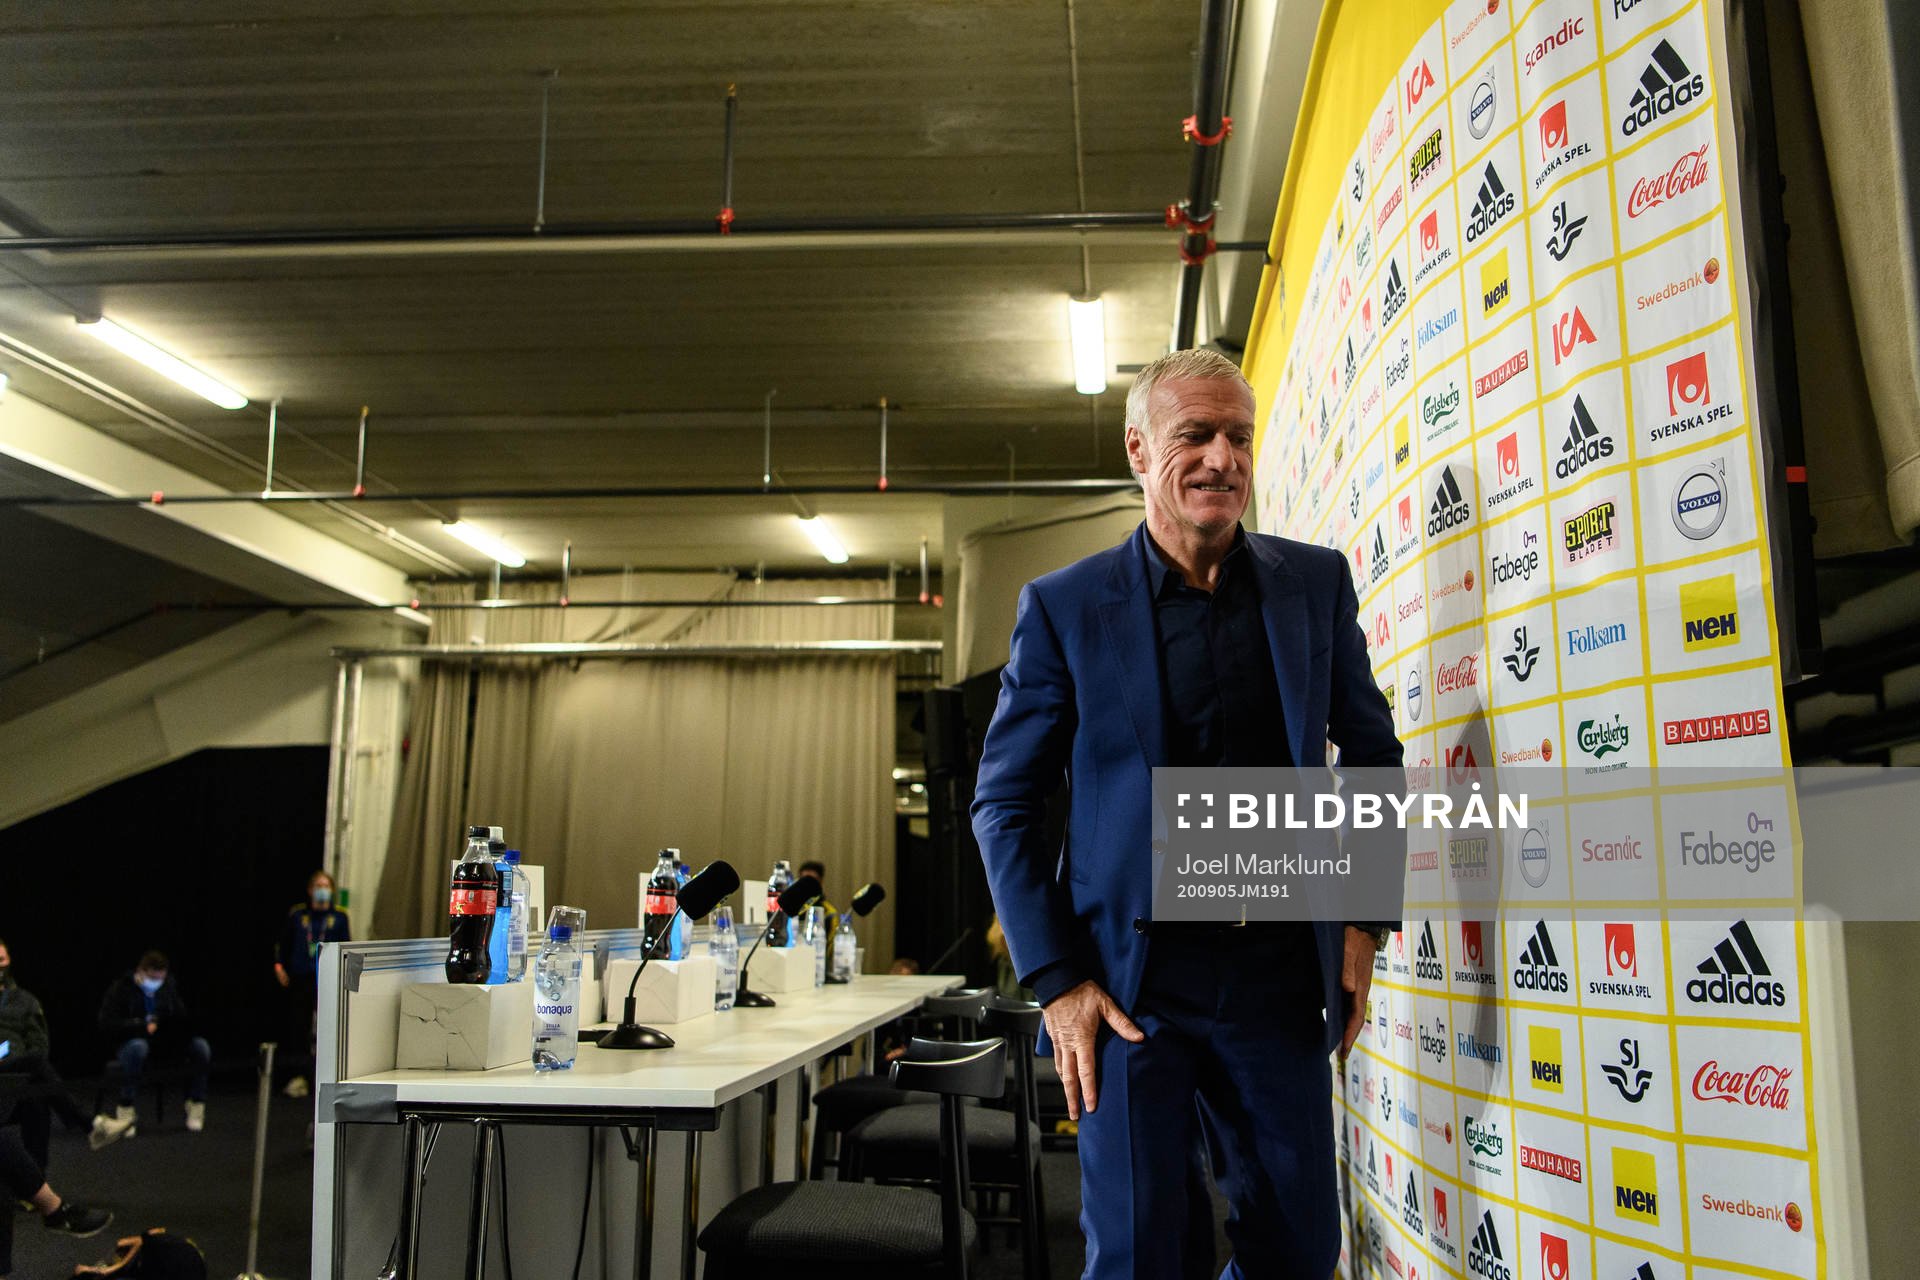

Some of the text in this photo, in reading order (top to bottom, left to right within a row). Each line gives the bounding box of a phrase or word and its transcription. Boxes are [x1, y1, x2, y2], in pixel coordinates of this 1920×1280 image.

[1451, 8, 1488, 49] Swedbank
[1525, 17, 1584, 76] Scandic
[1406, 58, 1435, 115] ICA
[1622, 74, 1704, 136] adidas
[1410, 128, 1442, 184] SPORT
[1535, 143, 1592, 190] SVENSKA SPEL
[1628, 141, 1710, 218] Coca-Cola
[1467, 192, 1515, 243] adidas
[1552, 201, 1567, 233] SJ
[1382, 287, 1407, 327] adidas
[1637, 272, 1703, 311] Swedbank
[1417, 308, 1458, 350] Folksam
[1552, 305, 1598, 366] ICA
[1475, 350, 1528, 398] BAUHAUS
[1423, 390, 1459, 425] Carlsberg
[1651, 404, 1734, 442] SVENSKA SPEL
[1556, 436, 1615, 480] adidas
[1488, 477, 1534, 508] SVENSKA SPEL
[1679, 493, 1720, 512] VOLVO
[1428, 503, 1470, 538] adidas
[1565, 502, 1615, 552] SPORT
[1569, 537, 1613, 563] BLADET
[1492, 551, 1539, 586] Fabege
[1432, 578, 1464, 601] Swedbank
[1514, 625, 1527, 652] SJ
[1567, 623, 1627, 656] Folksam
[1437, 652, 1478, 695] Coca-Cola
[1577, 719, 1629, 754] Carlsberg
[1665, 710, 1769, 744] BAUHAUS
[1445, 744, 1482, 786] ICA
[1502, 747, 1541, 764] Swedbank
[1449, 838, 1489, 869] SPORT
[1522, 849, 1547, 860] VOLVO
[1582, 834, 1642, 863] Scandic
[1680, 831, 1775, 873] Fabege
[1452, 869, 1488, 879] BLADET
[1416, 956, 1443, 981] adidas
[1455, 971, 1496, 985] SVENSKA SPEL
[1514, 965, 1568, 993] adidas
[1589, 982, 1651, 999] SVENSKA SPEL
[1686, 974, 1786, 1007] adidas
[1457, 1032, 1501, 1063] Folksam
[1620, 1039, 1639, 1069] SJ
[1692, 1060, 1793, 1110] Coca-Cola
[1464, 1115, 1503, 1155] Carlsberg
[1520, 1146, 1581, 1183] BAUHAUS
[1702, 1194, 1783, 1222] Swedbank
[1468, 1250, 1511, 1280] adidas
